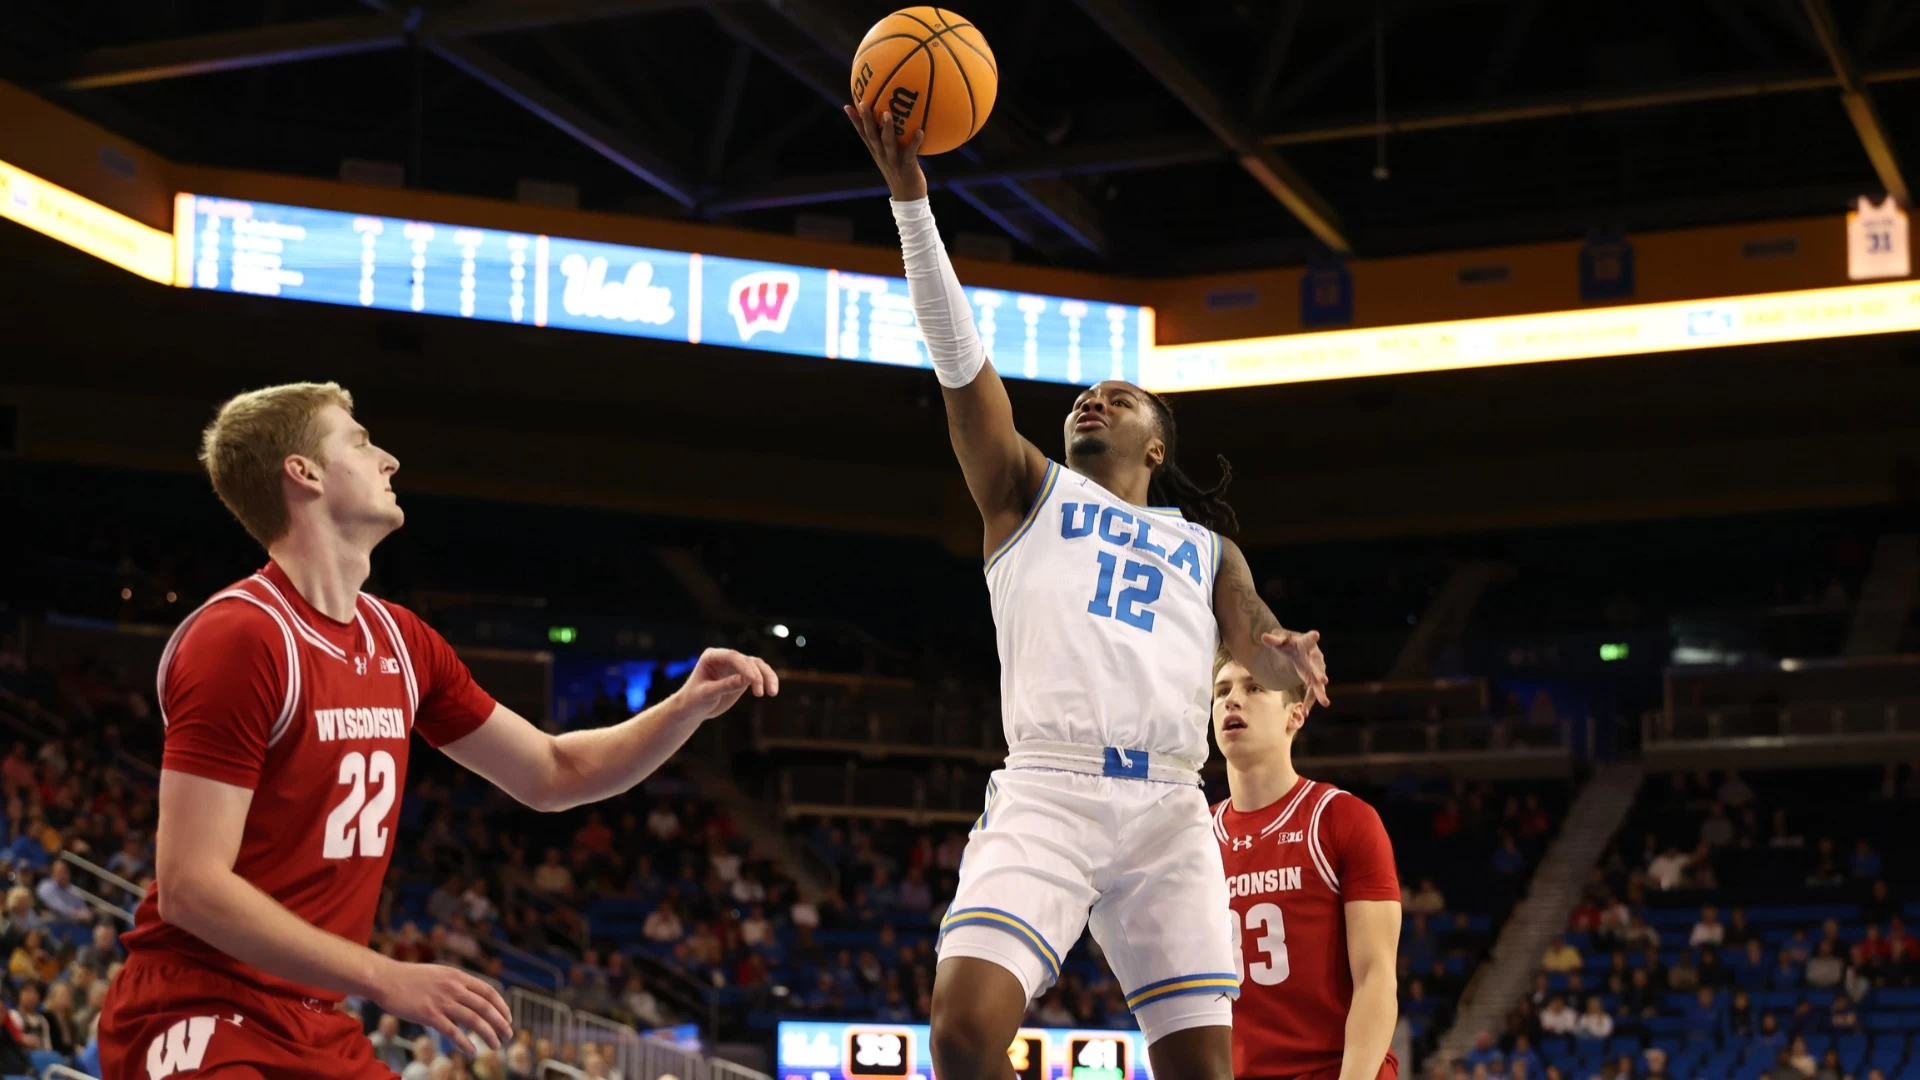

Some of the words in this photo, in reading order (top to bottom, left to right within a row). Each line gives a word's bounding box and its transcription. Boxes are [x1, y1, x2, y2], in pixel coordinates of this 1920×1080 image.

[734, 277, 794, 333] W
[1061, 502, 1202, 586] UCLA
[1087, 550, 1164, 633] 12
[315, 706, 406, 742] WISCONSIN
[322, 750, 397, 859] 22
[146, 1015, 219, 1080] W
